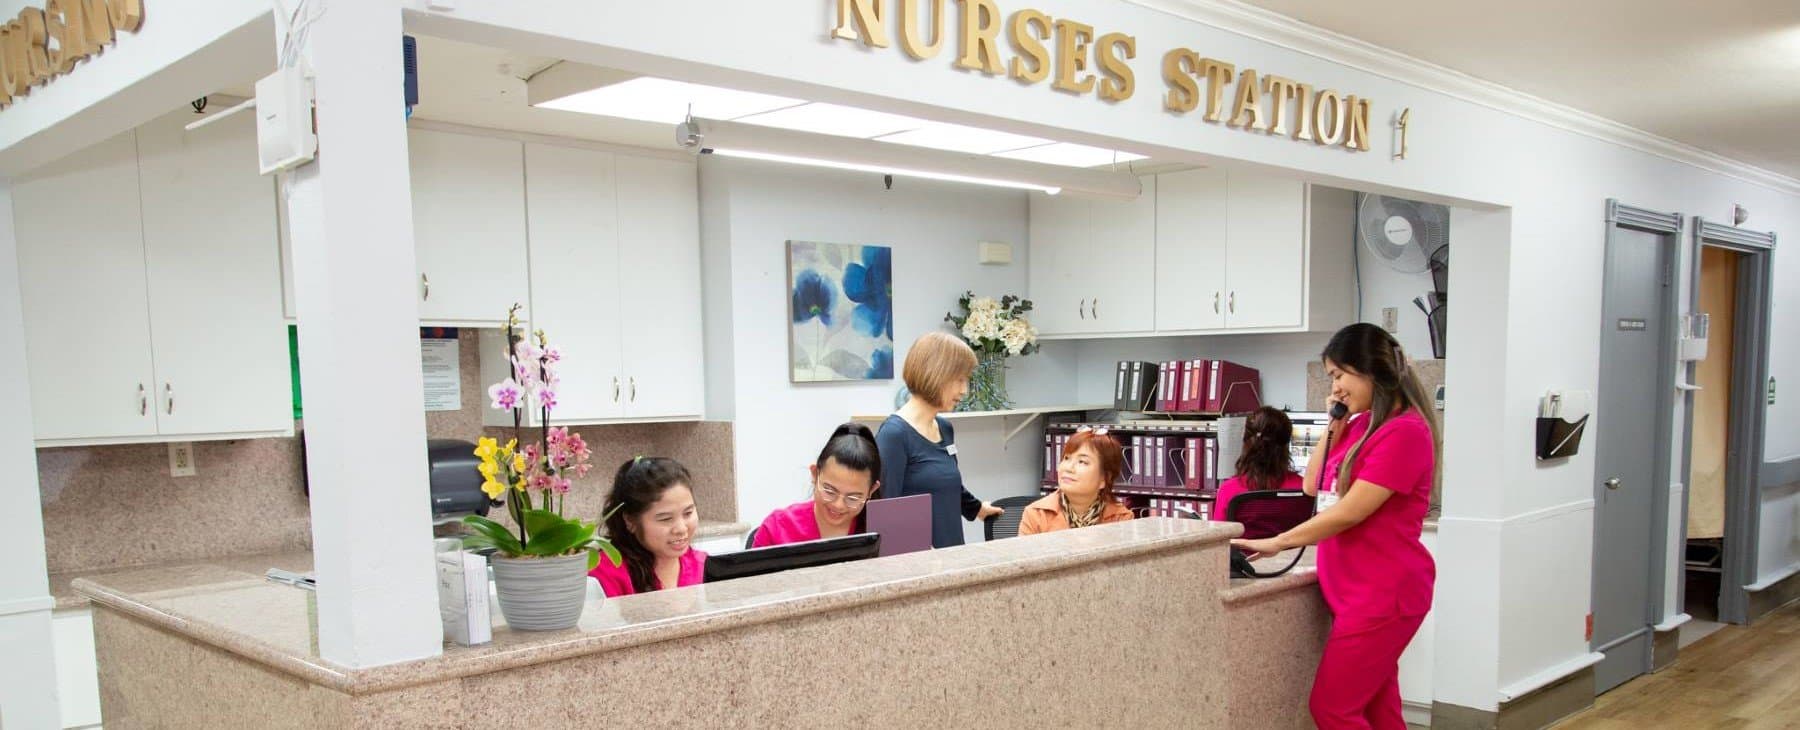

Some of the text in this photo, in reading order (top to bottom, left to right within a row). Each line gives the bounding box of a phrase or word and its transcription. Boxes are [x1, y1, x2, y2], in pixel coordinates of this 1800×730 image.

[831, 0, 1410, 161] NURSES STATION 1
